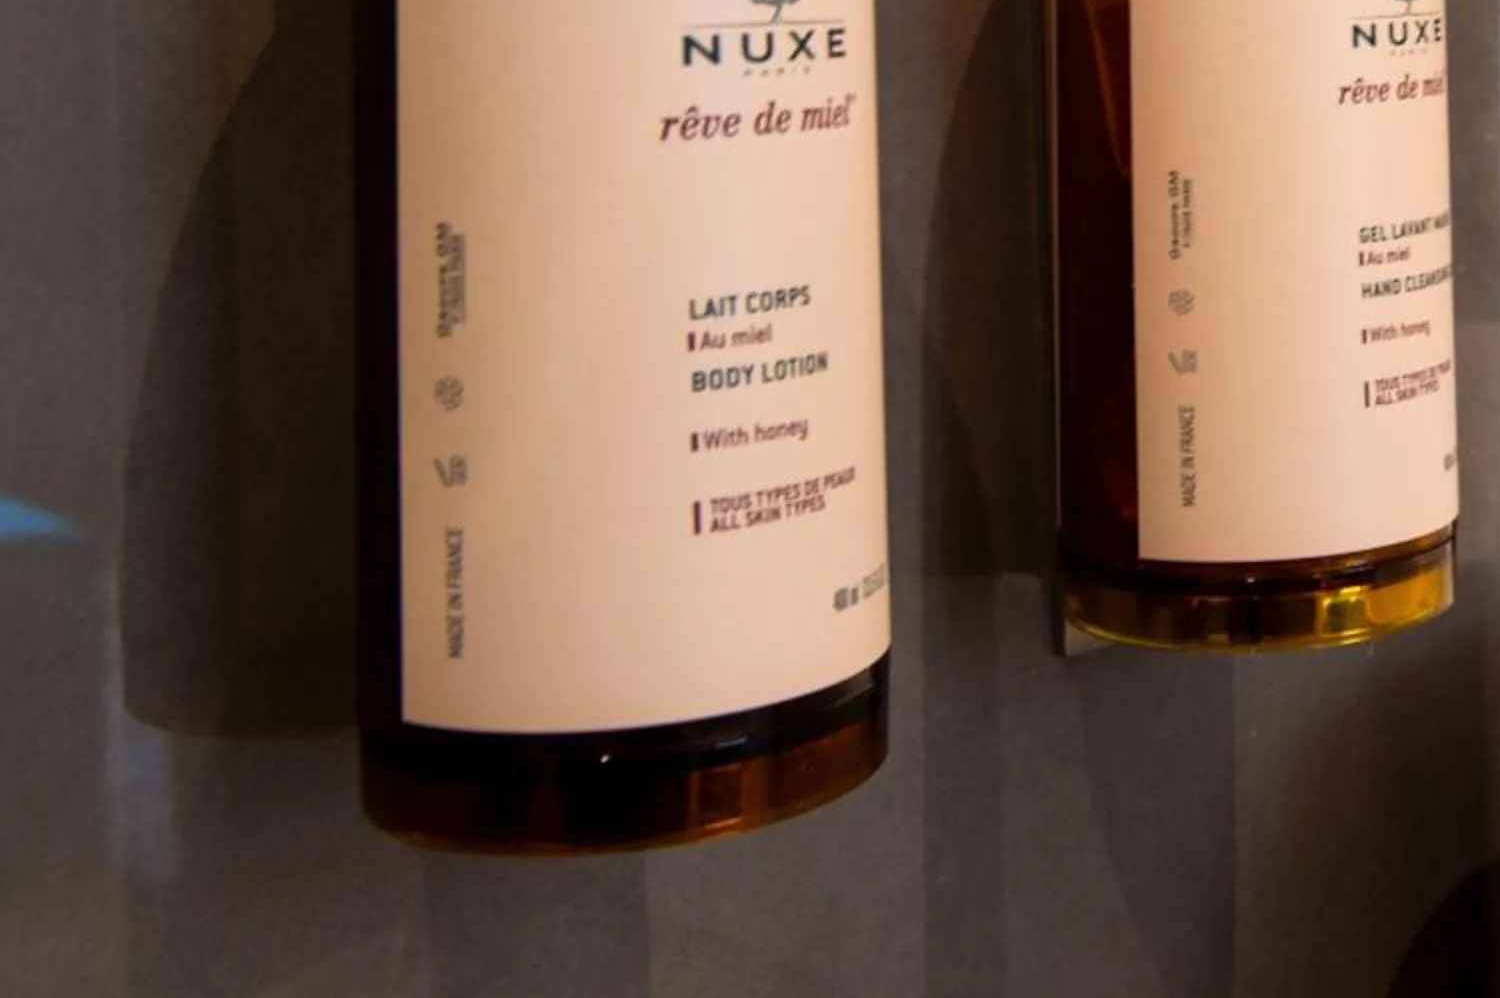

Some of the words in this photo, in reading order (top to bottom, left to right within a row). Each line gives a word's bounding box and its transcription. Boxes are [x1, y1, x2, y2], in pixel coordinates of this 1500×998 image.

[681, 27, 847, 67] NUXE
[1352, 18, 1442, 49] NUXE
[1338, 77, 1390, 105] rêve
[1396, 74, 1418, 100] de
[659, 105, 741, 142] rêve
[753, 100, 792, 137] de
[1358, 226, 1387, 244] GEL
[1367, 251, 1384, 266] Au
[688, 294, 740, 321] LAIT
[745, 284, 812, 315] CORPS
[1361, 278, 1402, 300] HAND
[700, 329, 726, 351] Au
[731, 322, 773, 347] miel
[1370, 323, 1398, 343] With
[691, 364, 755, 393] BODY
[761, 351, 829, 384] LOTION
[704, 426, 750, 452] With
[754, 418, 809, 443] honey
[709, 493, 753, 516] TOUS
[755, 482, 801, 509] TYPES
[803, 476, 822, 497] DE
[709, 512, 743, 534] ALL
[744, 505, 783, 529] SKIN
[784, 494, 827, 521] TYPES
